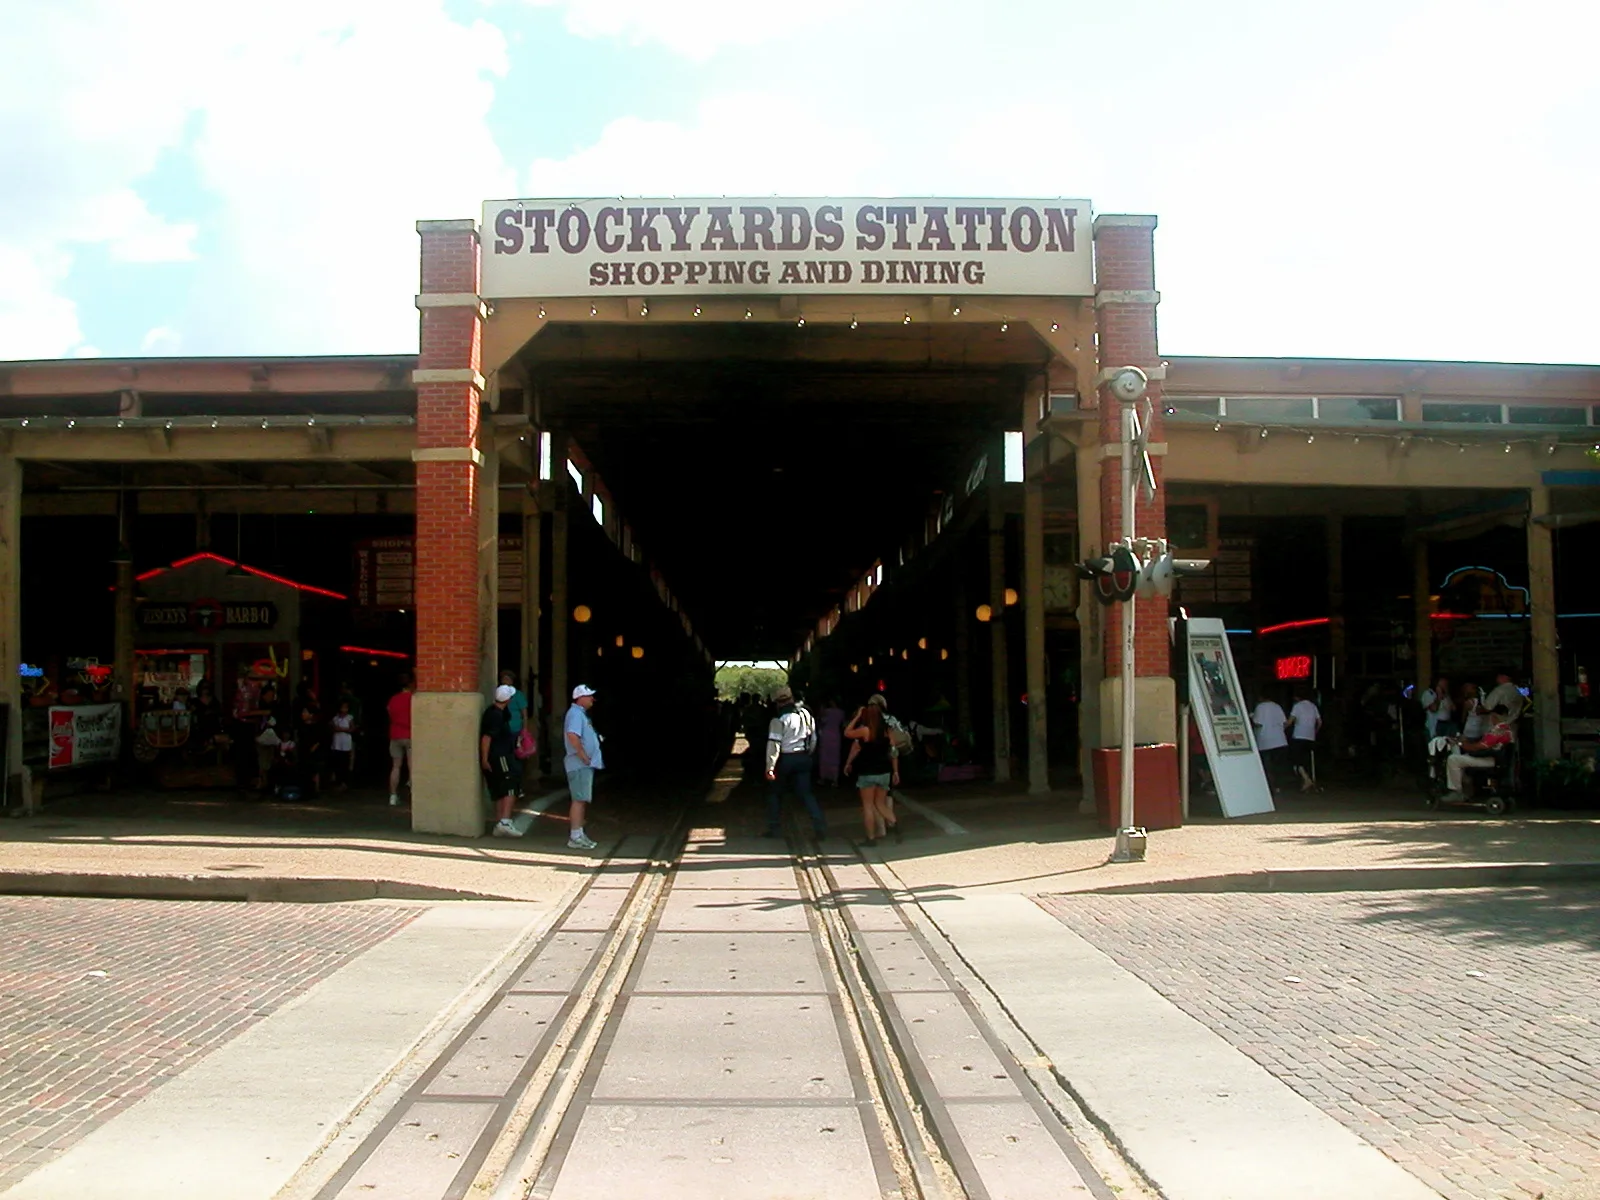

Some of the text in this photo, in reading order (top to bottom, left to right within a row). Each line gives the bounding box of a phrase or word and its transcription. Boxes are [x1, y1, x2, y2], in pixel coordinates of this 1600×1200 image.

[494, 207, 1077, 254] STOCKYARDS STATION
[589, 260, 985, 287] SHOPPING AND DINING
